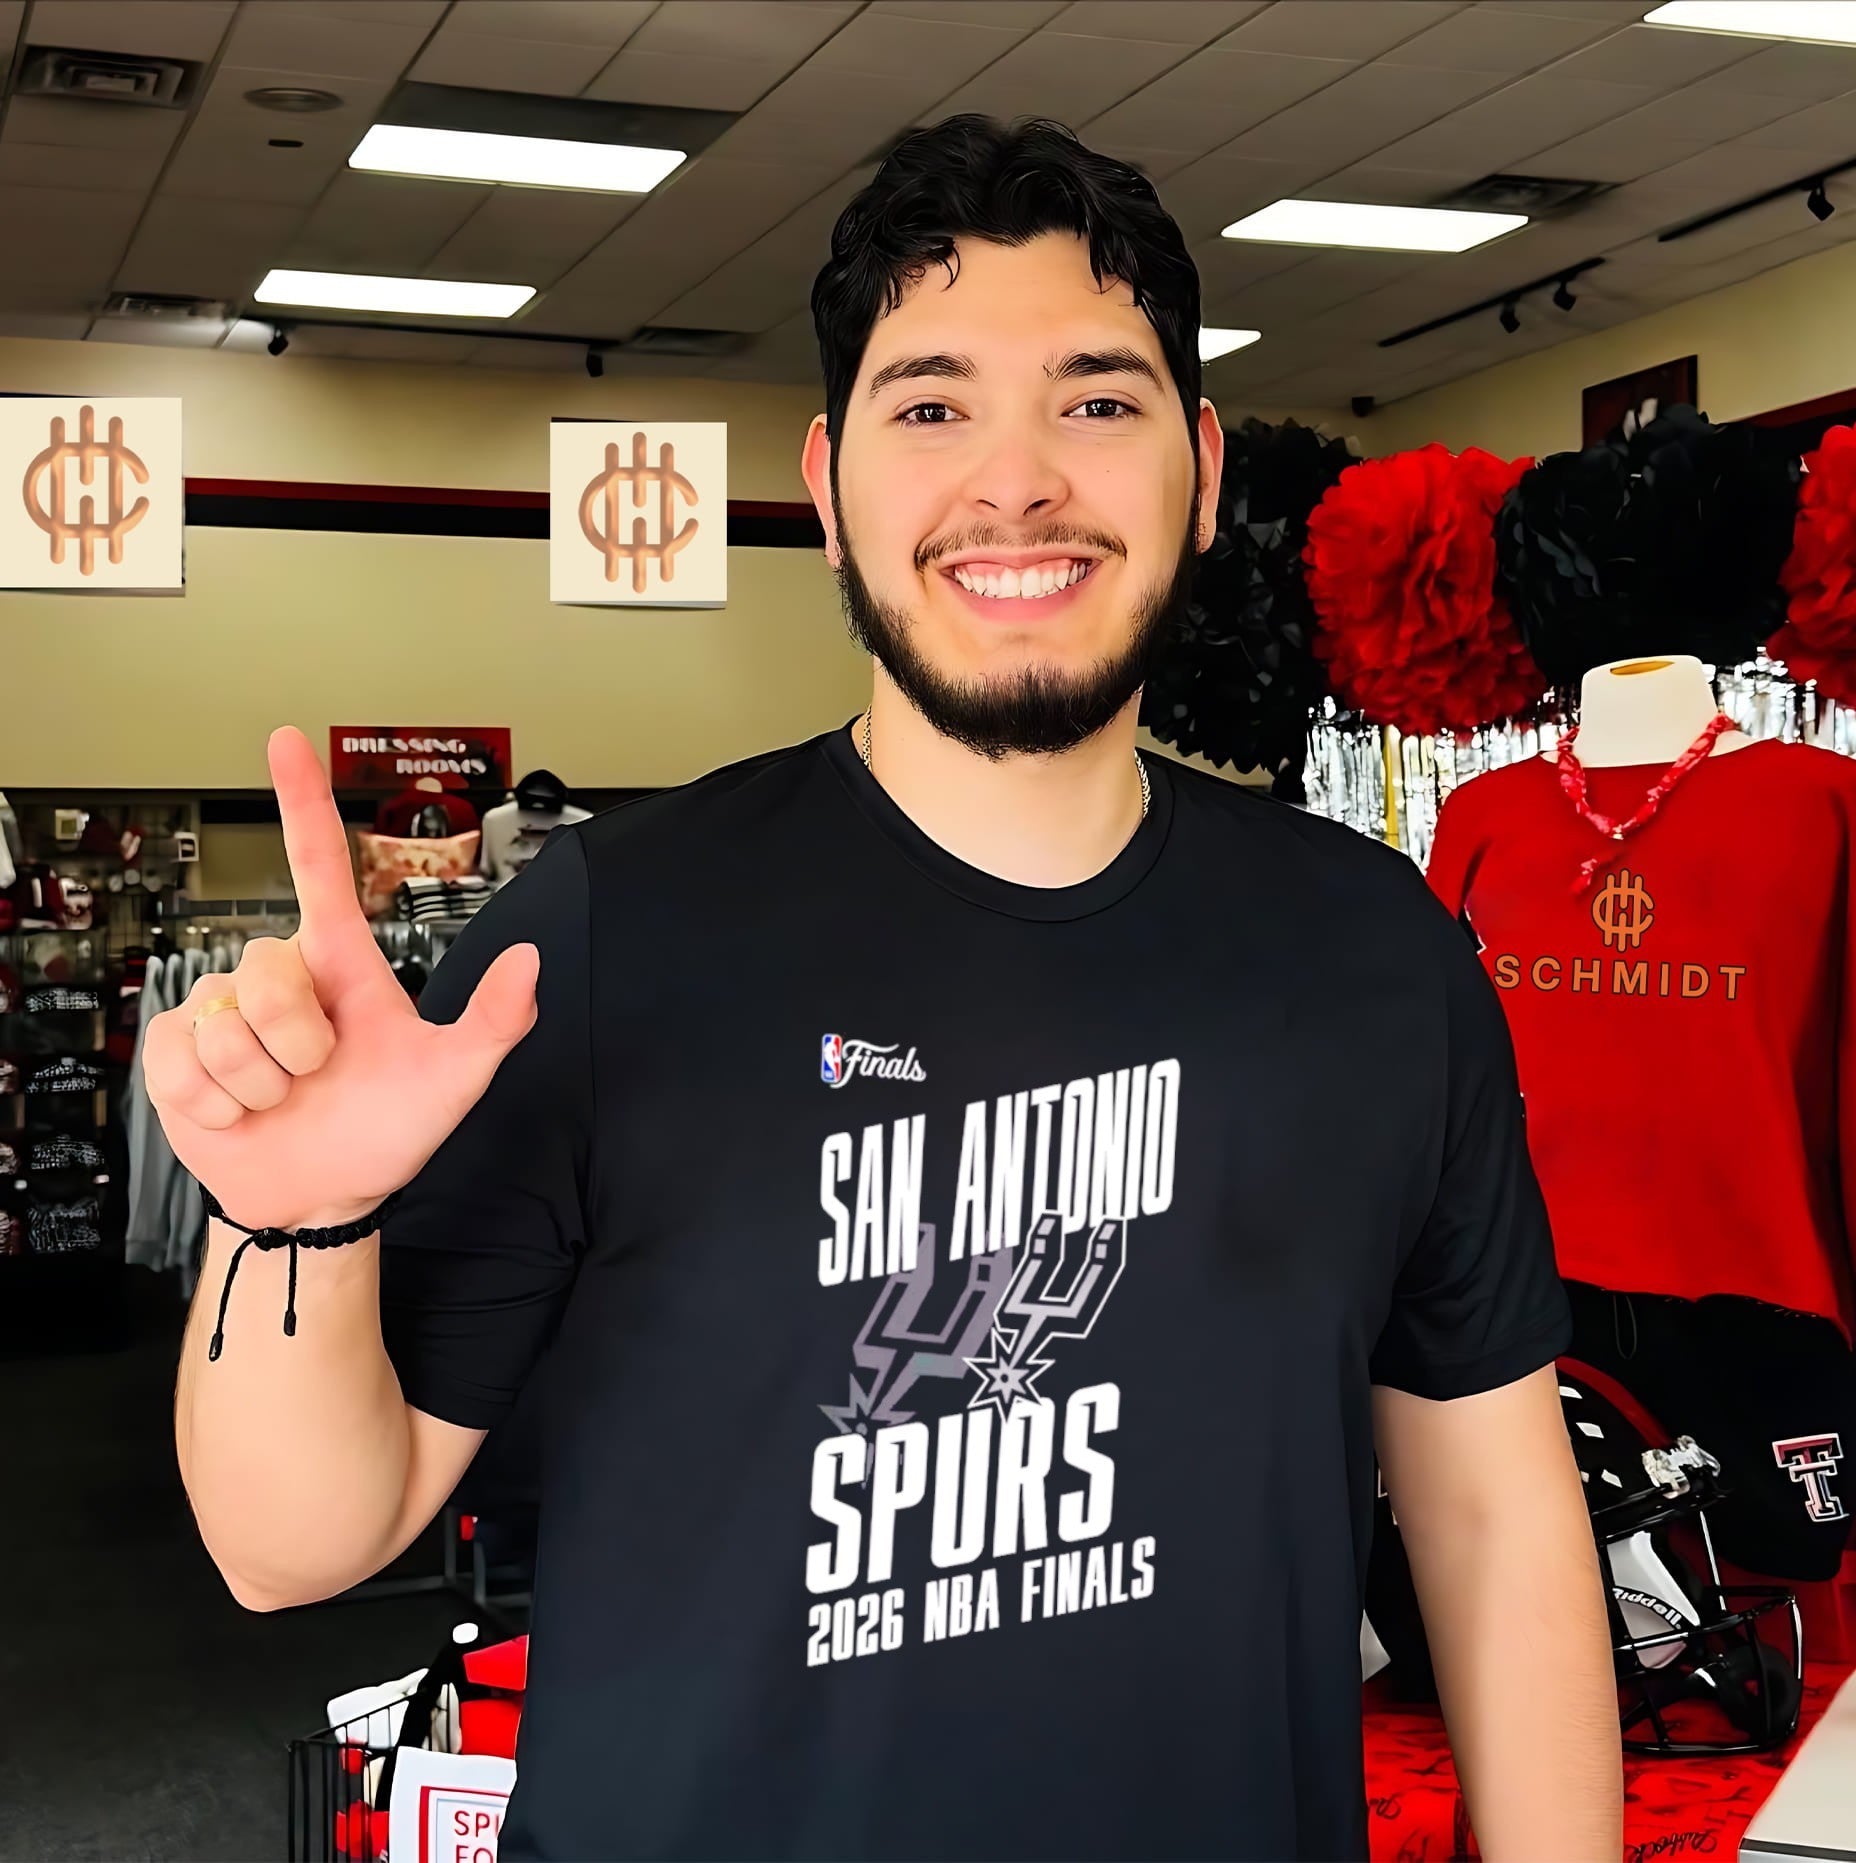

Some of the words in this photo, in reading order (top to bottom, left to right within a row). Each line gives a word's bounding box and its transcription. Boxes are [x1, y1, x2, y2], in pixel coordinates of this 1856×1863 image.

[342, 737, 467, 753] DRESSING
[396, 758, 487, 775] ROOMS
[1494, 953, 1747, 1001] SCHMIDT
[830, 1039, 927, 1090] Finals
[818, 1114, 926, 1287] SAN
[949, 1058, 1181, 1262] ANTONIO
[805, 1382, 1121, 1595] SPURS
[807, 1588, 905, 1667] 2026
[924, 1568, 1000, 1643] NBA
[1021, 1536, 1156, 1623] FINALS
